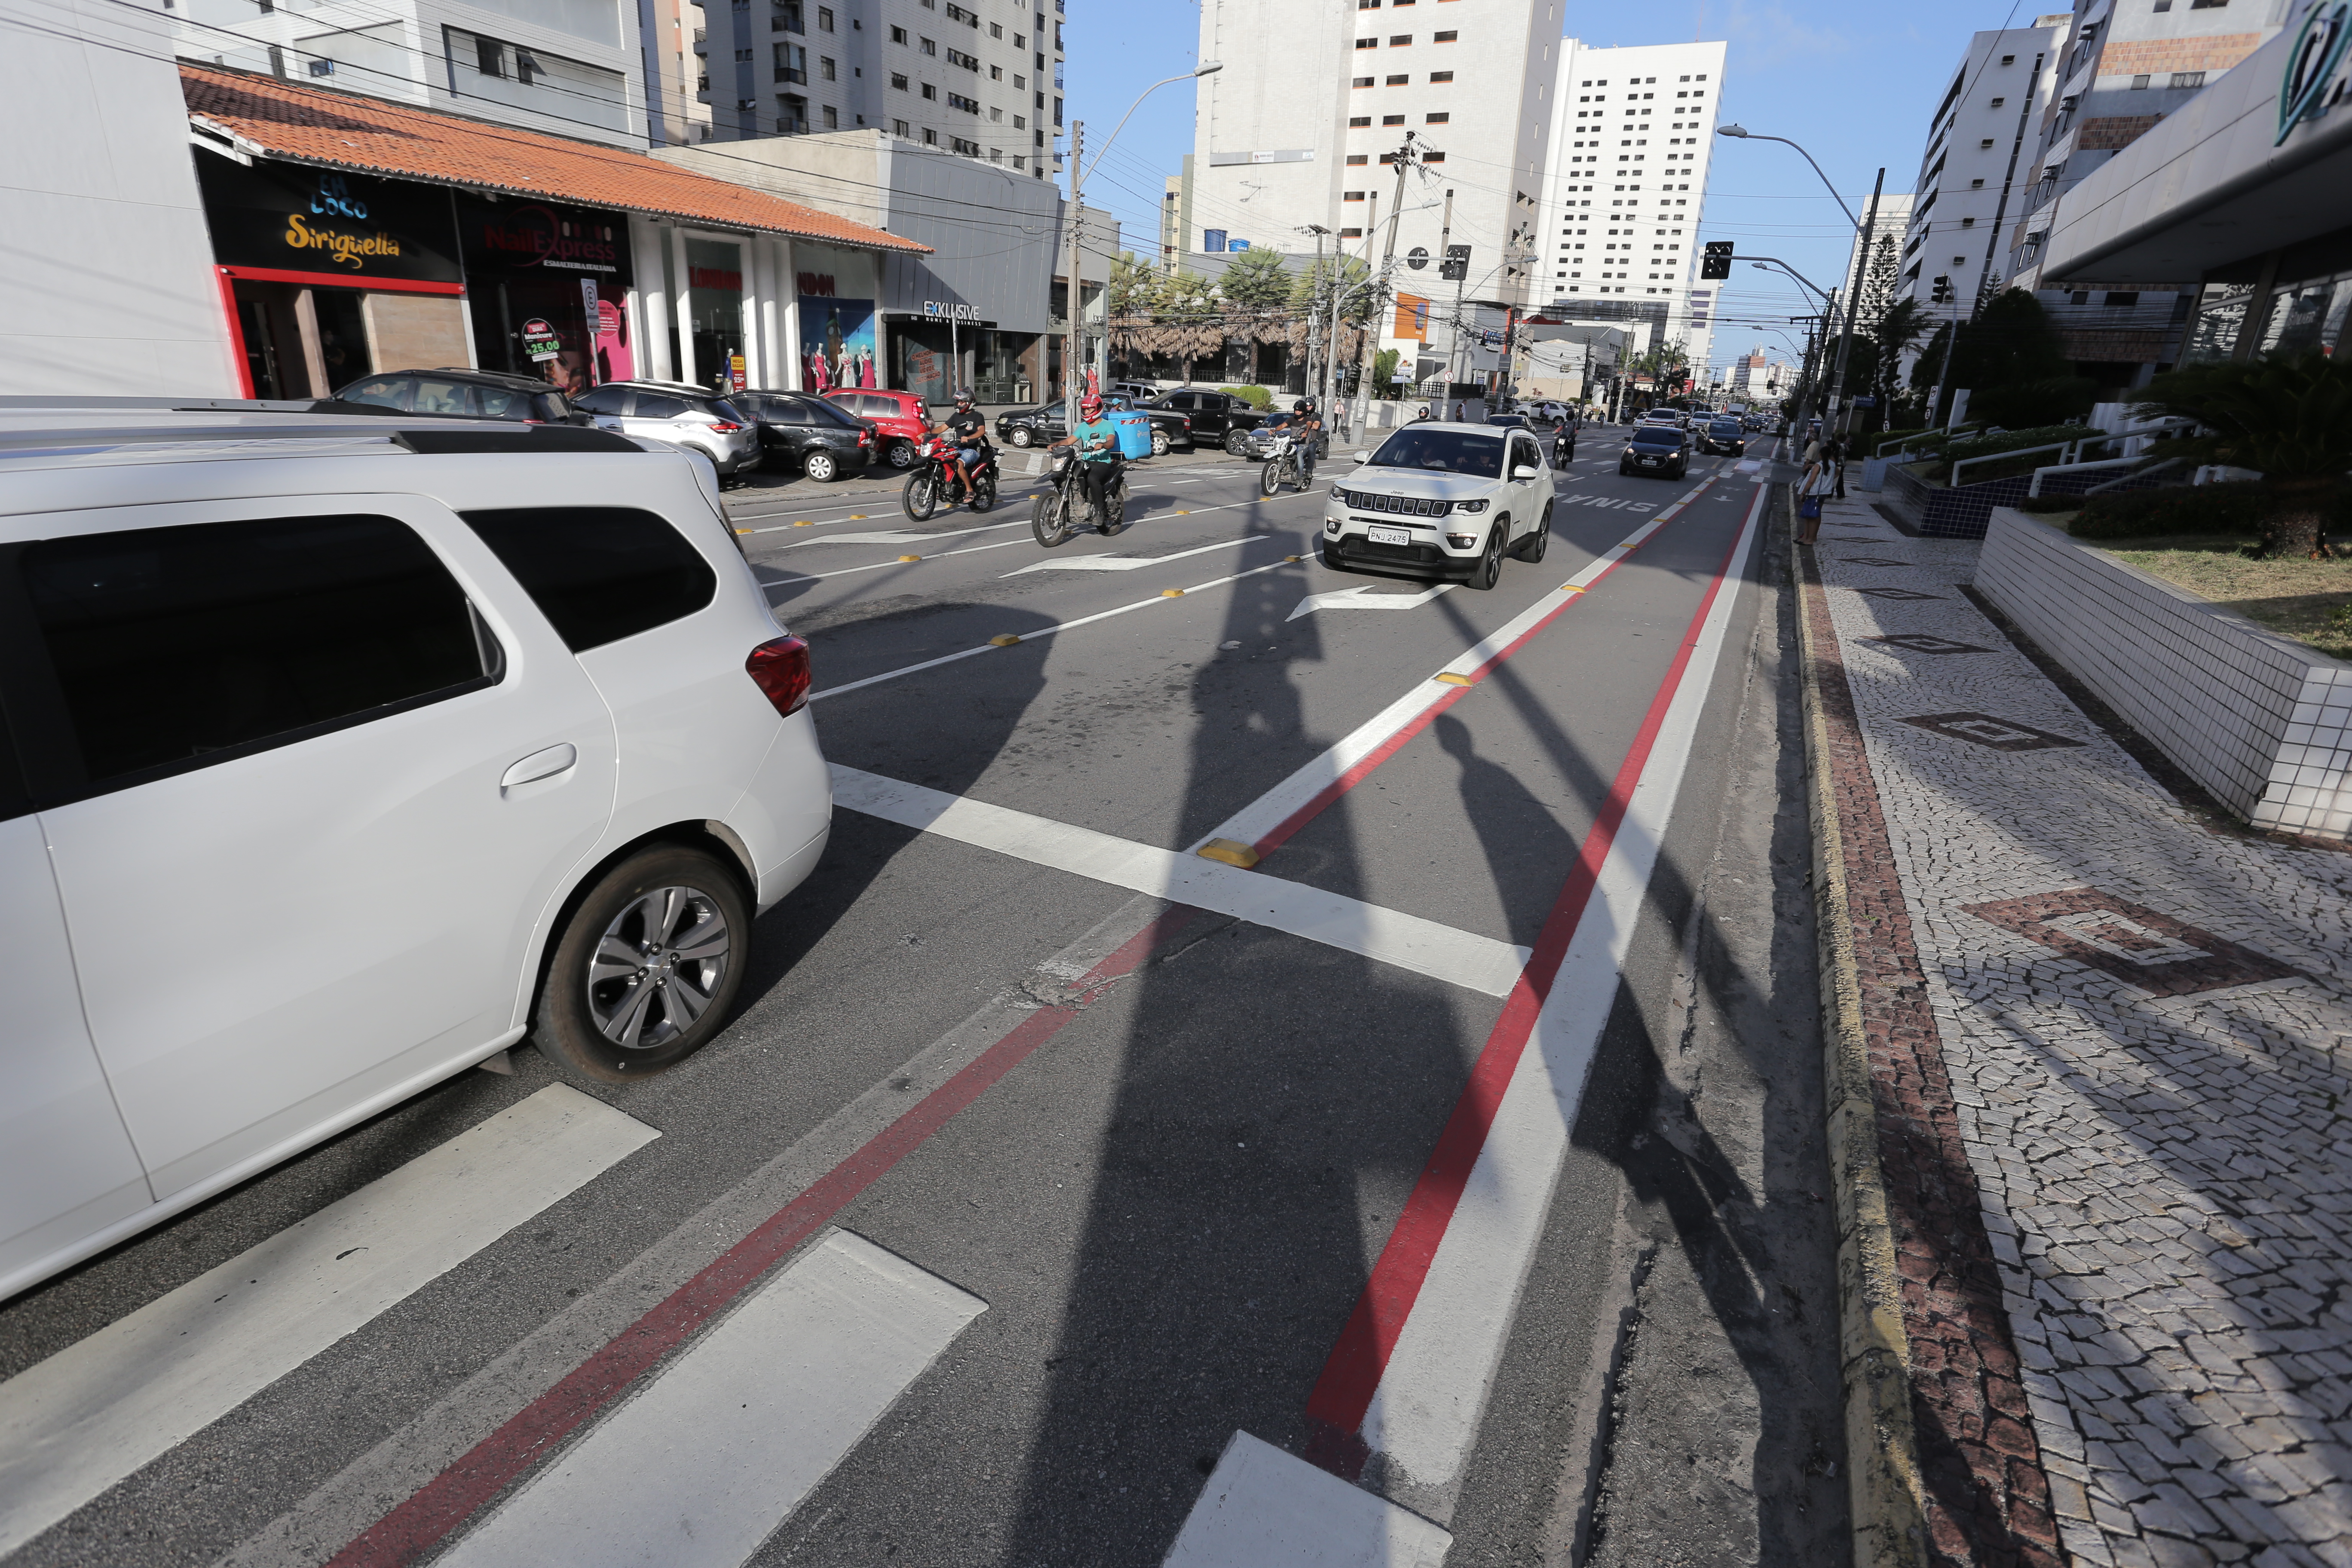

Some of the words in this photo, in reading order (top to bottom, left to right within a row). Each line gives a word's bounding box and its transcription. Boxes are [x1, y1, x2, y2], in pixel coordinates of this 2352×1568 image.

[319, 174, 348, 197] EH
[310, 194, 368, 219] LOCO
[543, 260, 585, 270] ESMALTERIA
[585, 263, 616, 272] ITALIANA
[689, 266, 742, 291] LONDON
[796, 272, 835, 297] NDON
[588, 291, 593, 304] E
[924, 300, 979, 321] EXKLUSIVE
[916, 349, 932, 358] MELHOR
[1387, 534, 1406, 543] 2475
